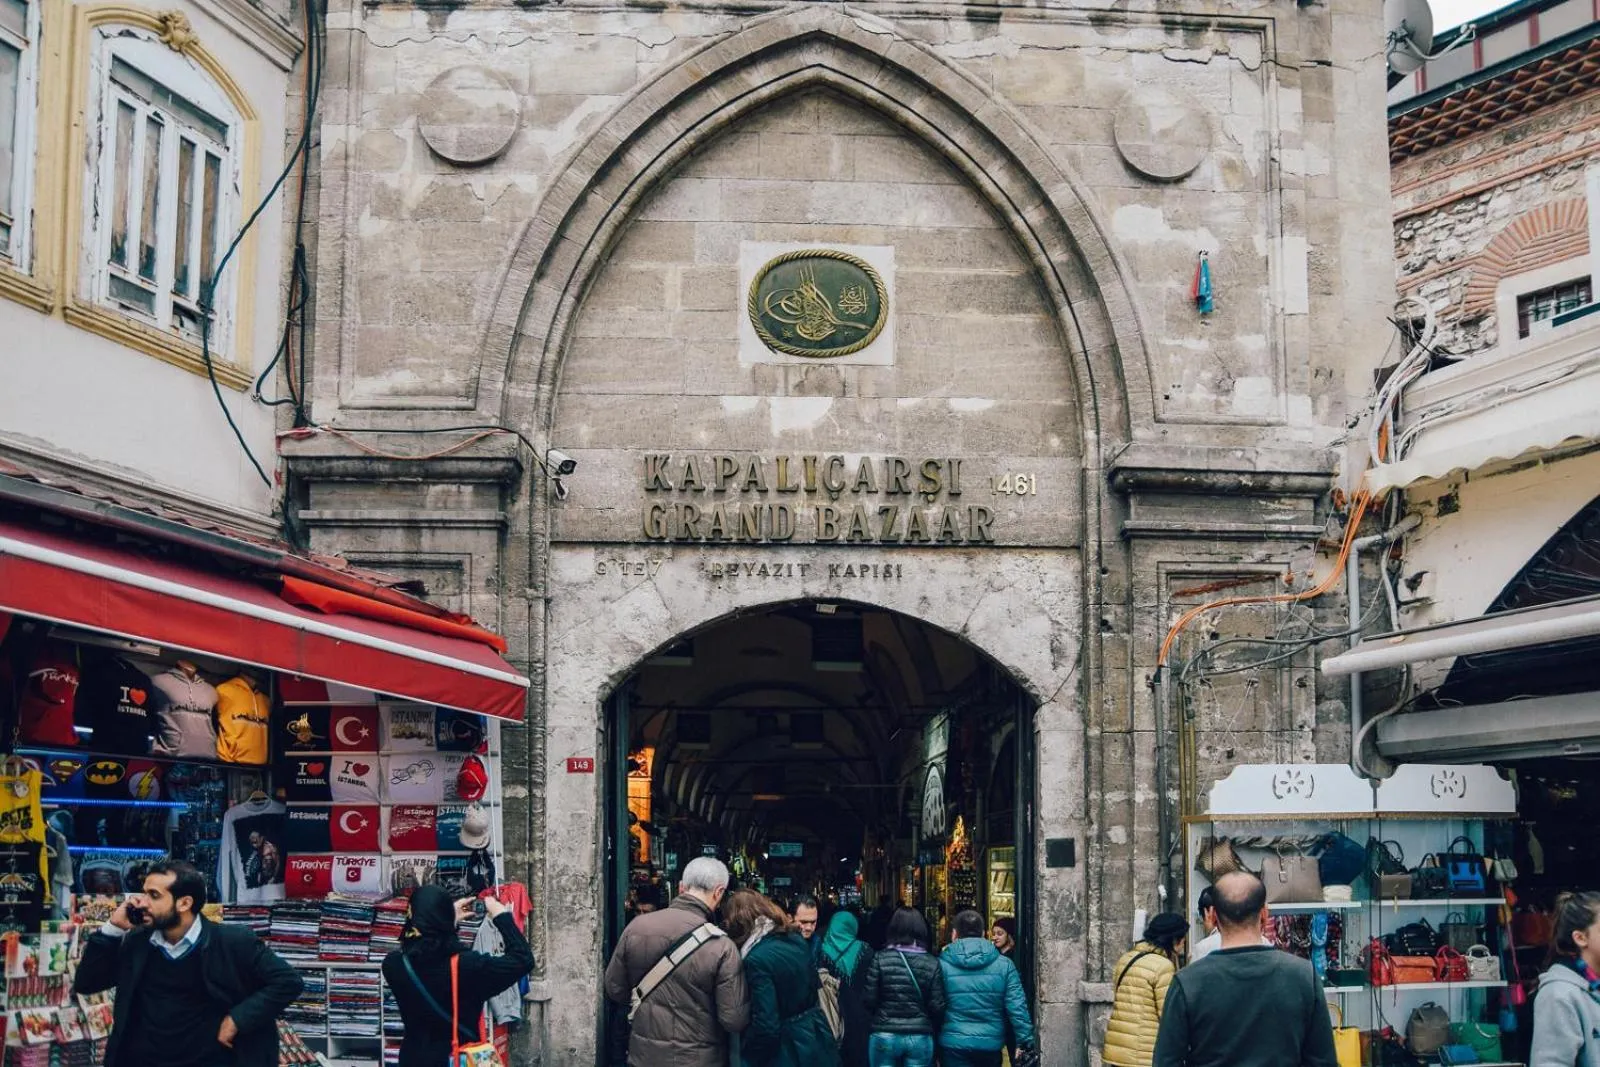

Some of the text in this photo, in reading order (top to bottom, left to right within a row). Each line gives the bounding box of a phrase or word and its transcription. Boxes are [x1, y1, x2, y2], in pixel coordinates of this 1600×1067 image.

[644, 454, 1037, 502] KAPALIÇARŞI 1461
[643, 503, 996, 543] GRAND BAZAAR
[595, 560, 646, 576] GTE
[711, 562, 903, 579] BEYAZIT KAPISI
[297, 762, 308, 776] I
[341, 760, 353, 774] I
[290, 859, 331, 871] TÜRKİYE
[336, 856, 377, 867] TÜRKİYE
